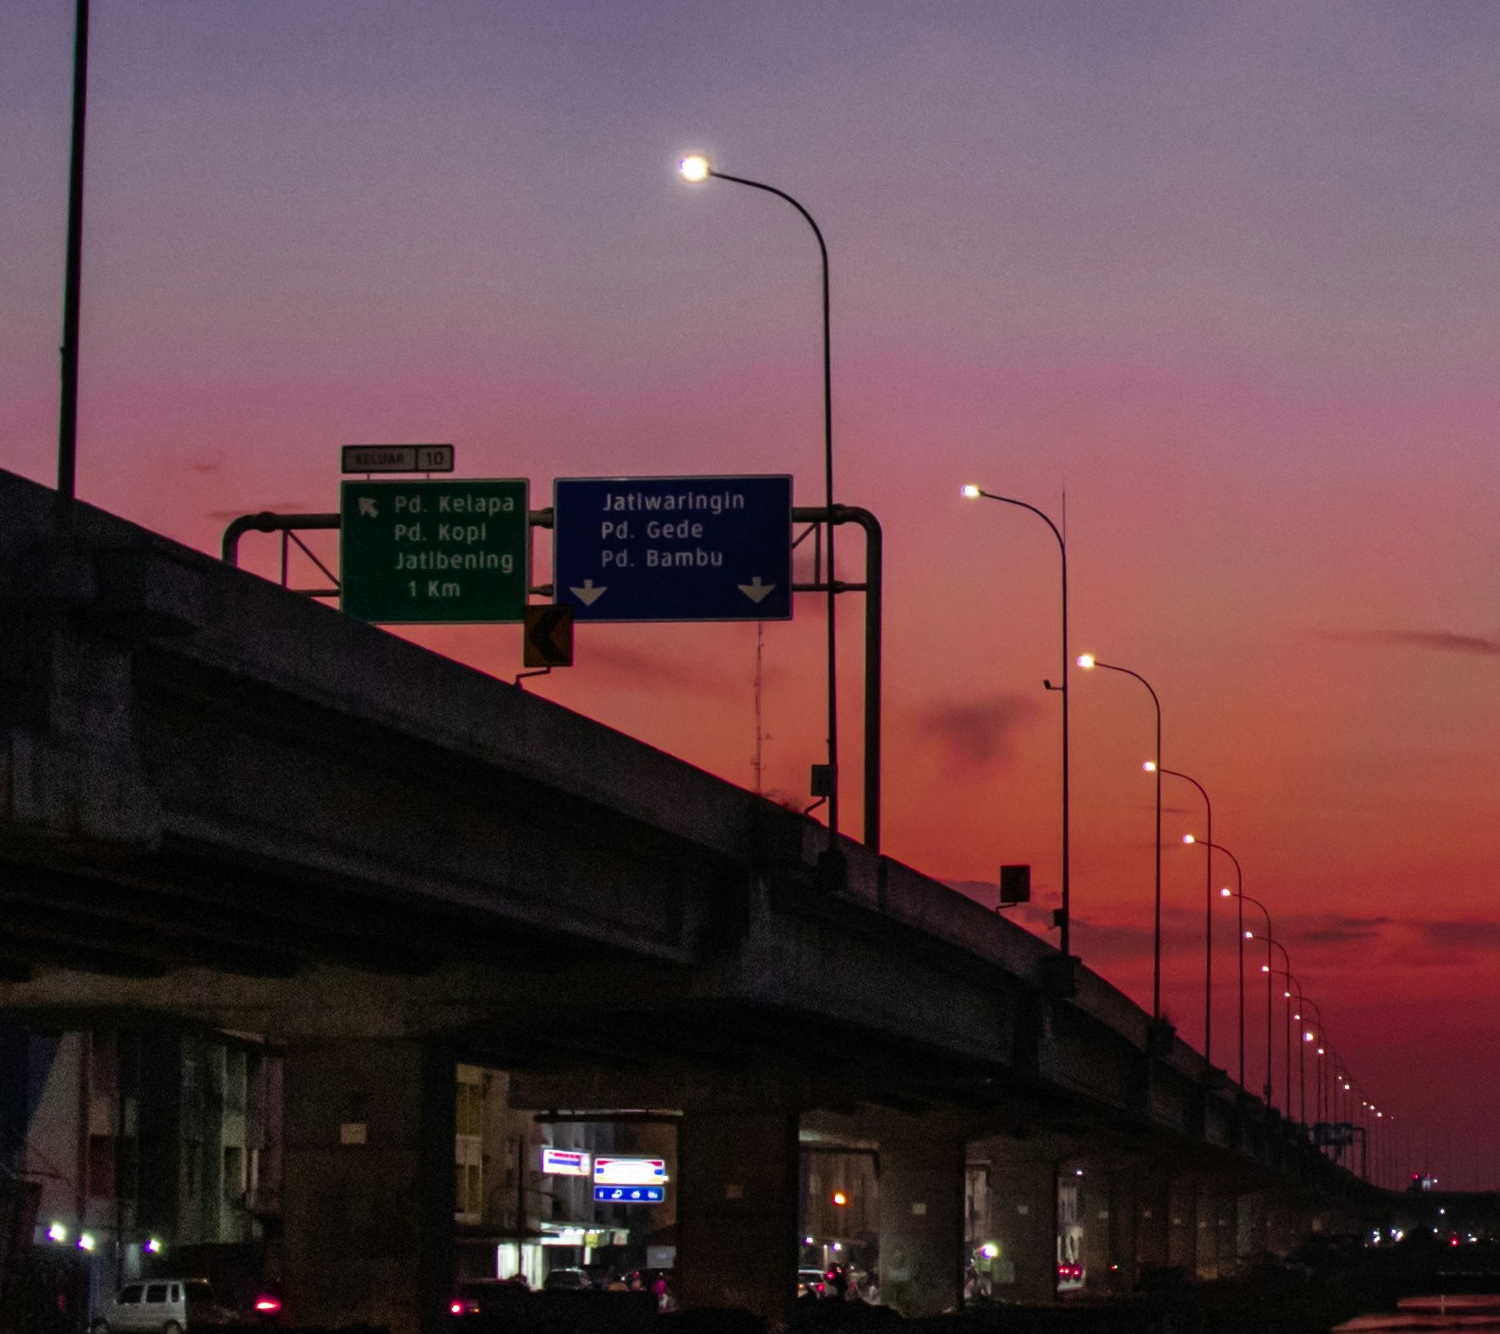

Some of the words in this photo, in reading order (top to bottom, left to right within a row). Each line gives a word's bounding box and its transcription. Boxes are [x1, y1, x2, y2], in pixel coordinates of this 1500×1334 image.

[355, 453, 404, 465] KELUAR
[426, 452, 444, 465] 10
[394, 495, 428, 513] Pd.
[438, 494, 515, 516] Kelapa
[602, 491, 745, 515] Jatiwaringin
[394, 523, 428, 541] Pd.
[438, 522, 487, 544] Kopi
[601, 521, 635, 539] Pd.
[646, 519, 704, 539] Gede
[396, 551, 514, 574] Jatibening
[601, 549, 635, 567] Pd.
[646, 548, 723, 567] Bambu
[408, 580, 417, 597] 1
[428, 580, 461, 597] Km
